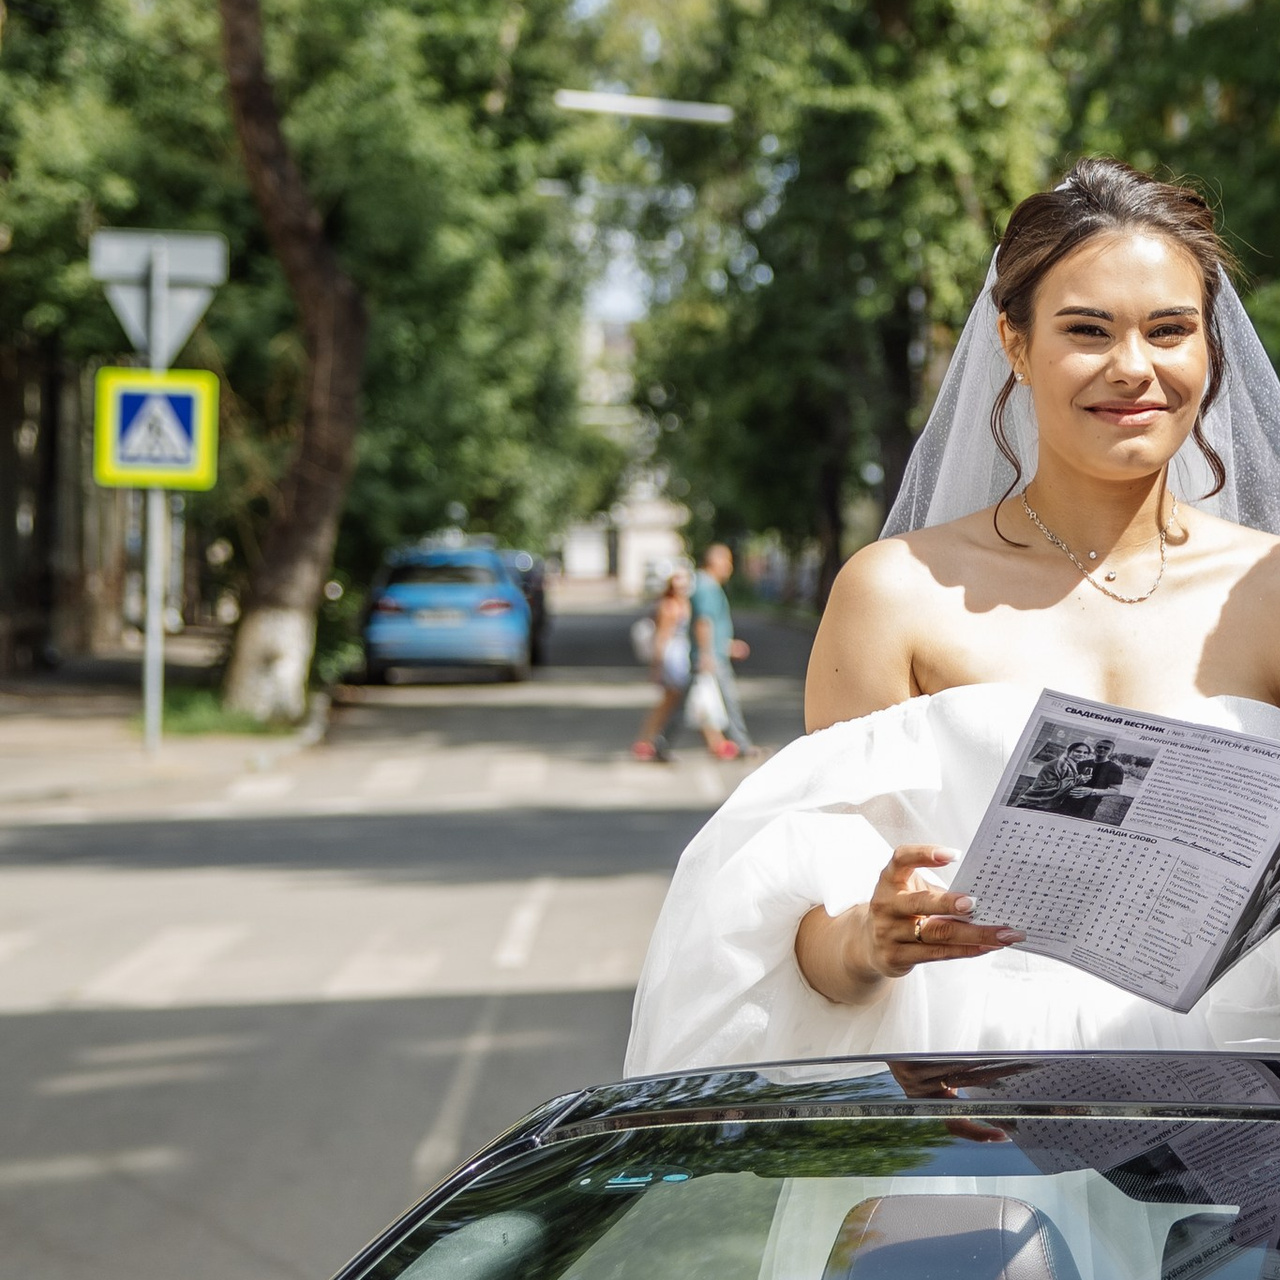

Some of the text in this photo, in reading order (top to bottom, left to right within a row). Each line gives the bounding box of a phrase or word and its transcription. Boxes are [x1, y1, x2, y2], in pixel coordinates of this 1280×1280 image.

[1064, 706, 1123, 724] СВАДЕБНЫЙ
[1124, 720, 1165, 733] ВЕСТНИК
[1210, 738, 1242, 750] АНТОН
[1178, 752, 1213, 763] счастливы,
[1235, 766, 1261, 776] пришли
[1180, 759, 1206, 768] радость
[1207, 765, 1231, 773] нашего
[1231, 771, 1268, 785] свадебного
[1157, 766, 1184, 776] подарок,
[1223, 782, 1241, 790] рады
[1177, 764, 1216, 777] присутствие
[1221, 774, 1243, 783] самый
[1243, 781, 1269, 792] ценный
[1165, 774, 1200, 785] особенное
[1200, 782, 1228, 792] событие
[1232, 791, 1251, 800] кругу
[1250, 797, 1274, 808] друзей
[1148, 782, 1175, 792] Начиная
[1190, 793, 1229, 806] прекрасный
[1229, 803, 1268, 819] совместный
[1173, 795, 1204, 806] особенно
[1204, 803, 1237, 816] ощущаем,
[1238, 814, 1270, 828] насколько
[1180, 804, 1217, 816] поддержка.
[1136, 806, 1259, 847] воспоминания, наполненные любовью,
[1139, 799, 1268, 842] Давайте создадим вместе незабываемые
[1097, 827, 1158, 844] НАЙДИ СЛОВО
[1130, 817, 1153, 825] особое
[1153, 822, 1173, 830] место
[1178, 829, 1199, 837] наших
[1199, 836, 1225, 847] сердцах
[1133, 811, 1157, 820] смехом
[1163, 818, 1198, 831] общением
[1202, 830, 1220, 838] теми,
[1233, 840, 1262, 855] занимает
[1180, 860, 1199, 870] Танцы
[1172, 874, 1201, 888] Верность
[1176, 868, 1200, 879] Счастье
[1169, 881, 1209, 899] Путешествие
[1221, 885, 1246, 899] Любовь
[1225, 878, 1250, 892] Свадьба
[1165, 888, 1199, 904] Романтика
[1218, 893, 1242, 906] Невеста
[1210, 906, 1231, 918] Клятва
[1214, 900, 1234, 911] Жених
[1152, 915, 1166, 924] Мир
[1155, 909, 1175, 919] Семья
[1206, 914, 1229, 926] Кольца
[1148, 925, 1164, 934] Слова
[1165, 933, 1180, 941] могут
[1199, 927, 1216, 937] Букет
[1203, 921, 1230, 935] Поцелуй
[1144, 932, 1181, 949] расположены
[1149, 941, 1177, 955] вертикали
[1196, 934, 1217, 946] Платье
[1147, 955, 1181, 972] горизонтали
